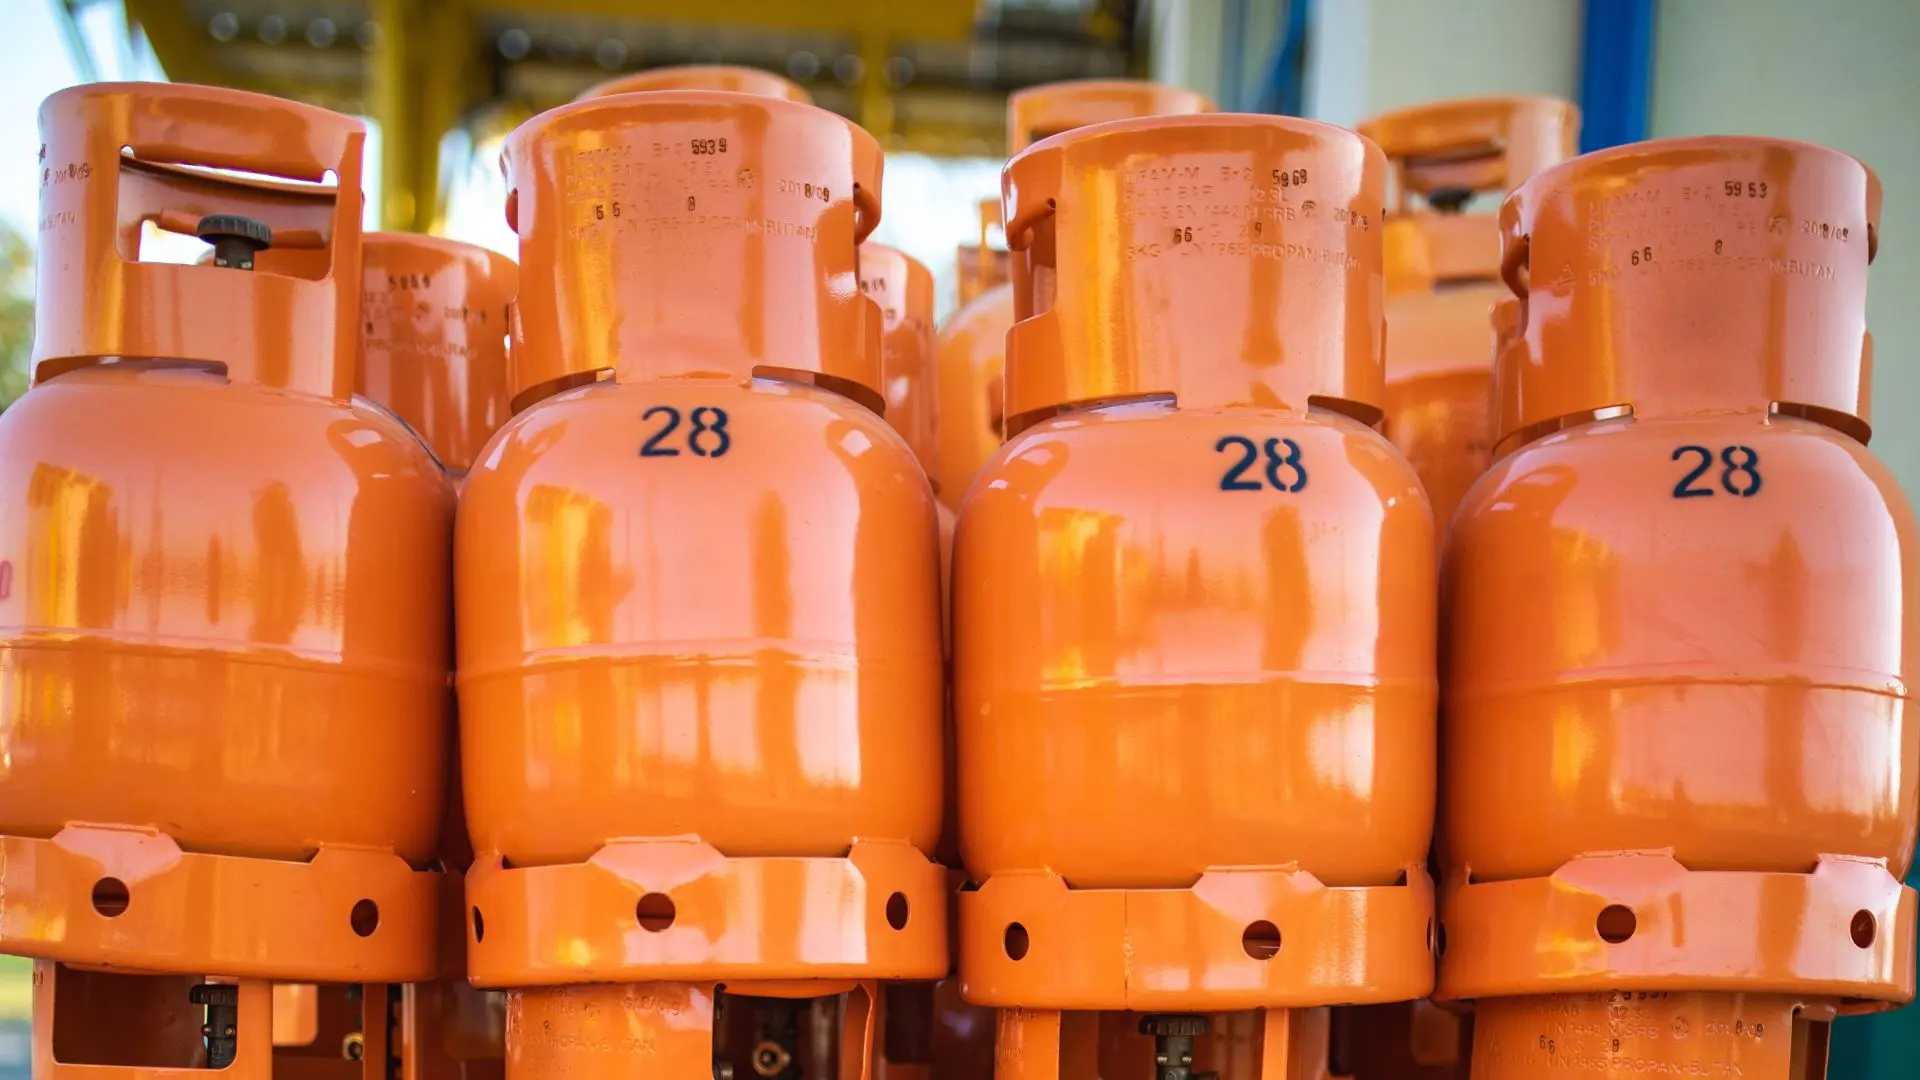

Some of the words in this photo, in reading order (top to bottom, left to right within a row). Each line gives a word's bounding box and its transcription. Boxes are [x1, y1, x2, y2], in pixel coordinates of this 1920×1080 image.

[640, 405, 731, 458] 28
[1215, 435, 1308, 493] 28
[1671, 445, 1763, 498] 28
